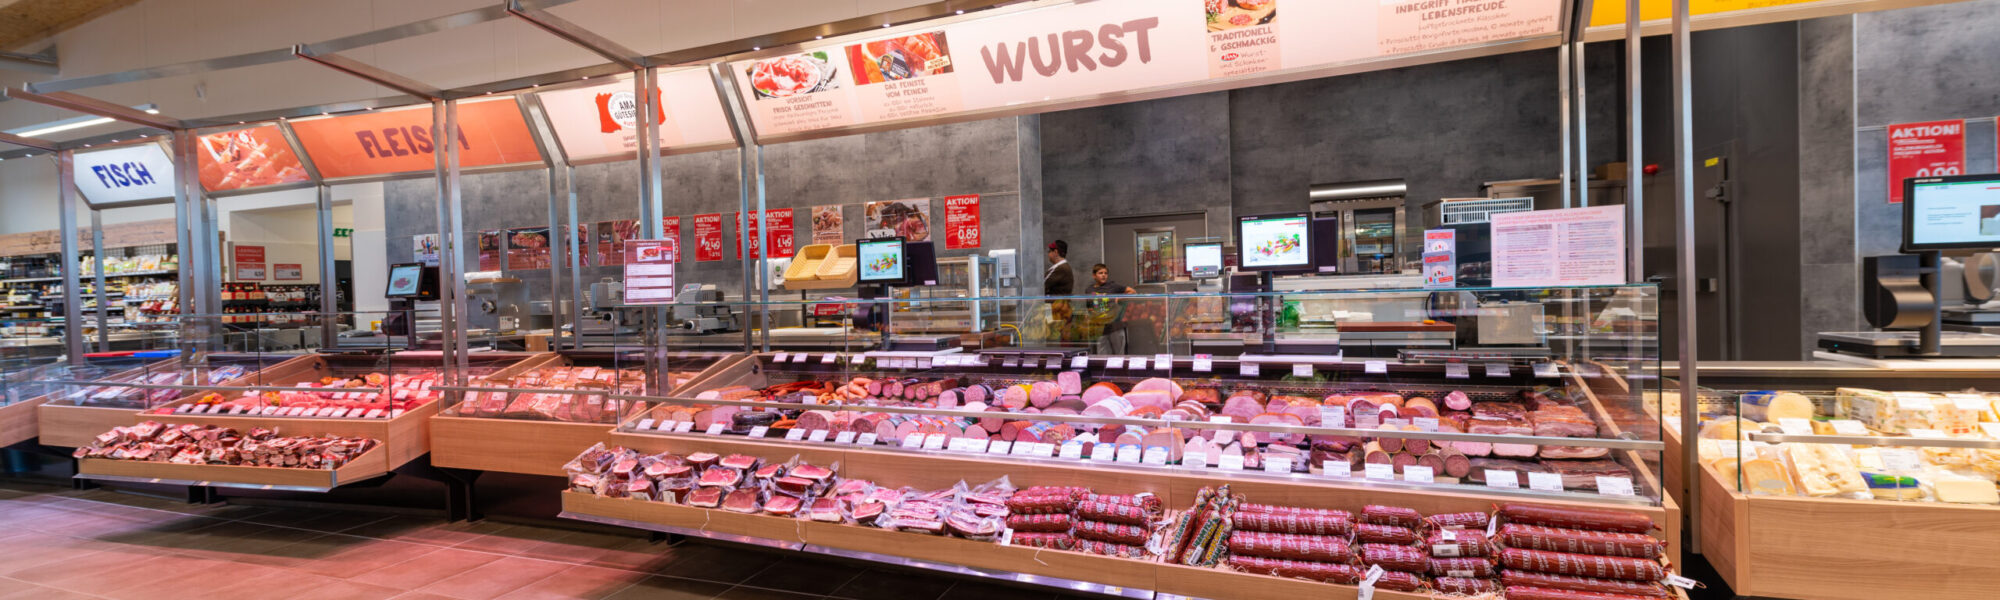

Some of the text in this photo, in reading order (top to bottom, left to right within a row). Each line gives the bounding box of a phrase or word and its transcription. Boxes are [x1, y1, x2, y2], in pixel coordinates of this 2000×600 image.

[1211, 26, 1273, 42] TRADITIONELL
[980, 16, 1159, 84] WURST
[1220, 36, 1276, 51] GSCHMACKIG
[619, 100, 636, 110] AMA
[1891, 124, 1961, 138] AKTION!
[91, 161, 157, 189] FISCH
[946, 197, 979, 206] AKTION!
[958, 228, 978, 240] 0.89
[704, 241, 721, 251] 2.49
[777, 238, 793, 248] 1.49
